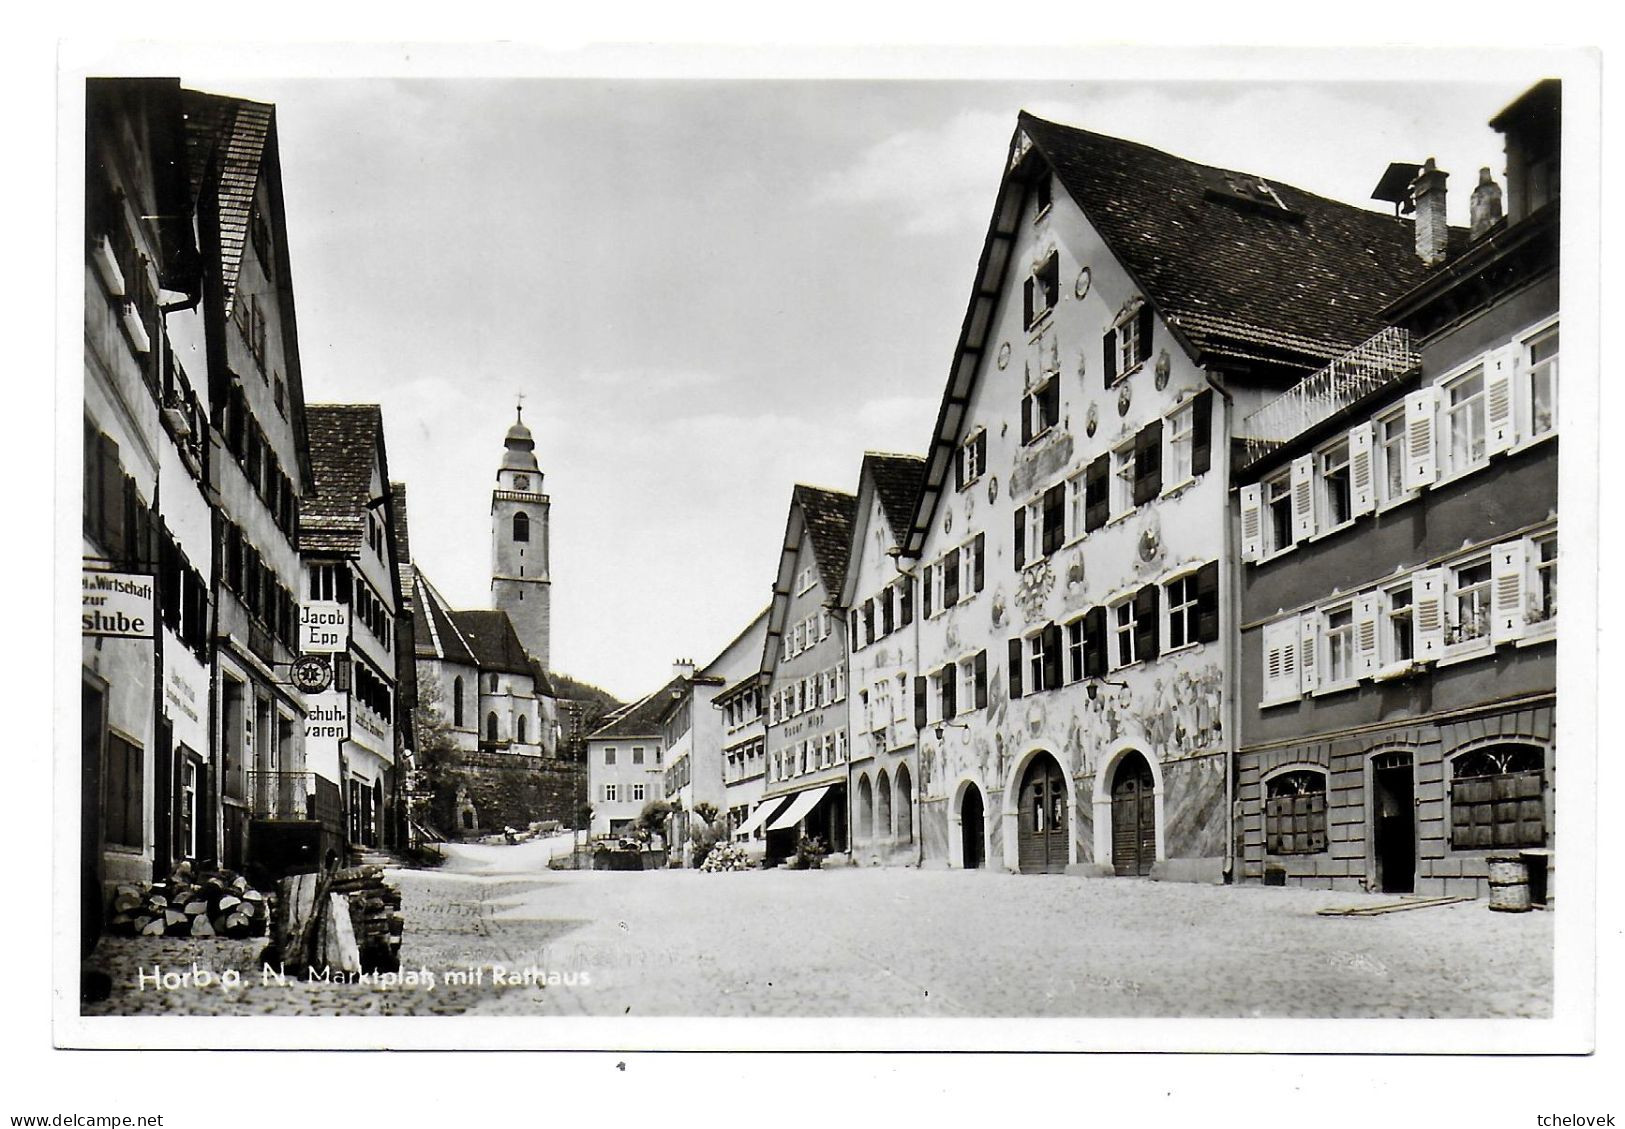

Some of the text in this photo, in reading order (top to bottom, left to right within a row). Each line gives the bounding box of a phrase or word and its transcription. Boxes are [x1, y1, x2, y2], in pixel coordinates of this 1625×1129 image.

[82, 596, 108, 606] zur
[301, 606, 345, 625] Jacob
[309, 626, 338, 645] Epp
